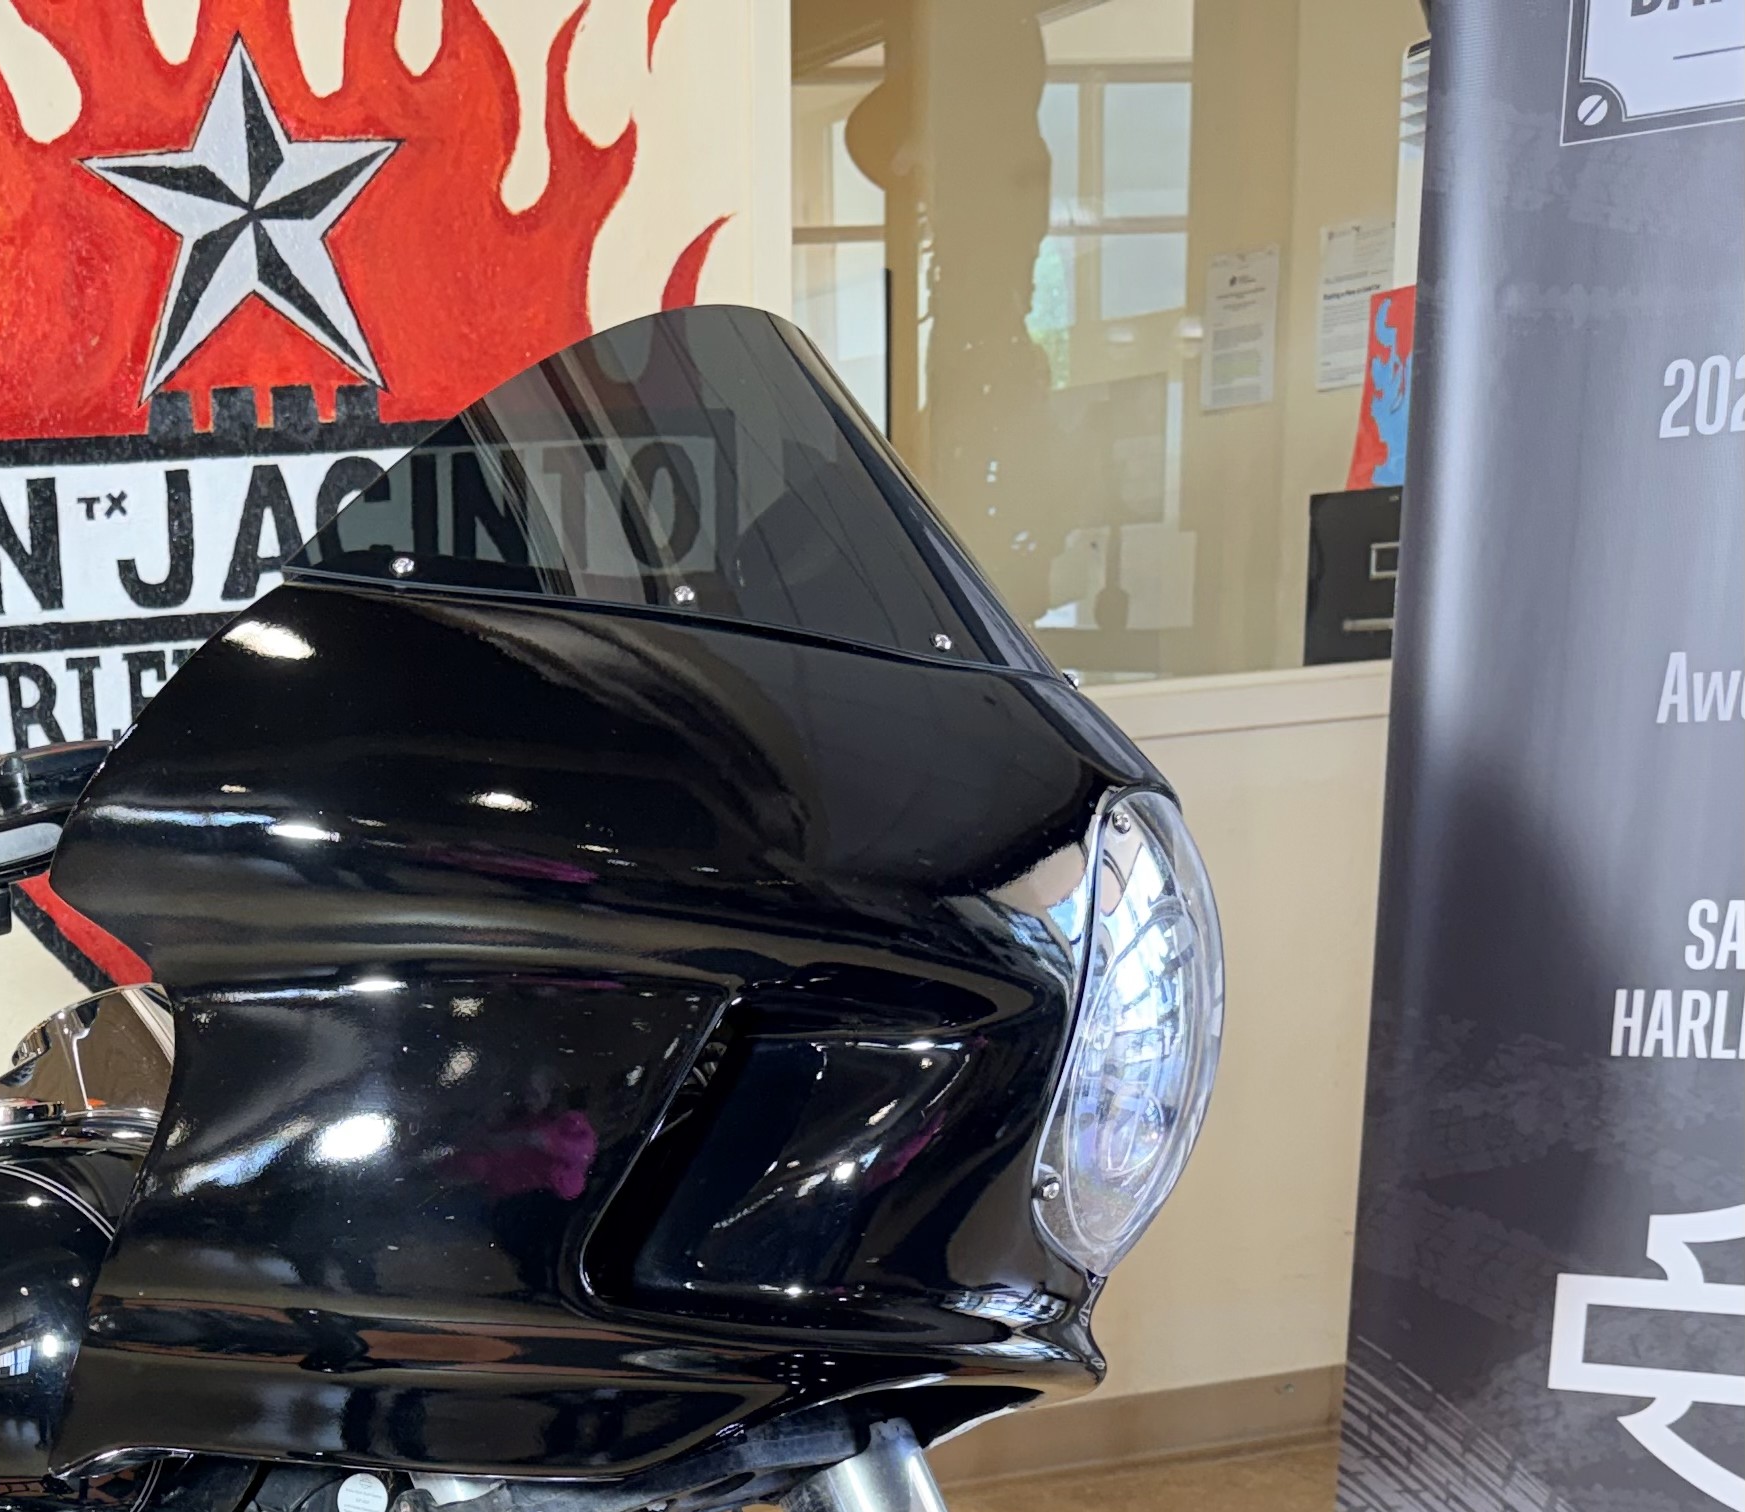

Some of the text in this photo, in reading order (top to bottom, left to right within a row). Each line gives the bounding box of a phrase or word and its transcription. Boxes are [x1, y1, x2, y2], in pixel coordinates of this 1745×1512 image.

[77, 490, 128, 521] TX
[117, 439, 702, 612] JACINTO
[1656, 651, 1745, 725] Aw
[1609, 987, 1745, 1060] HARL
